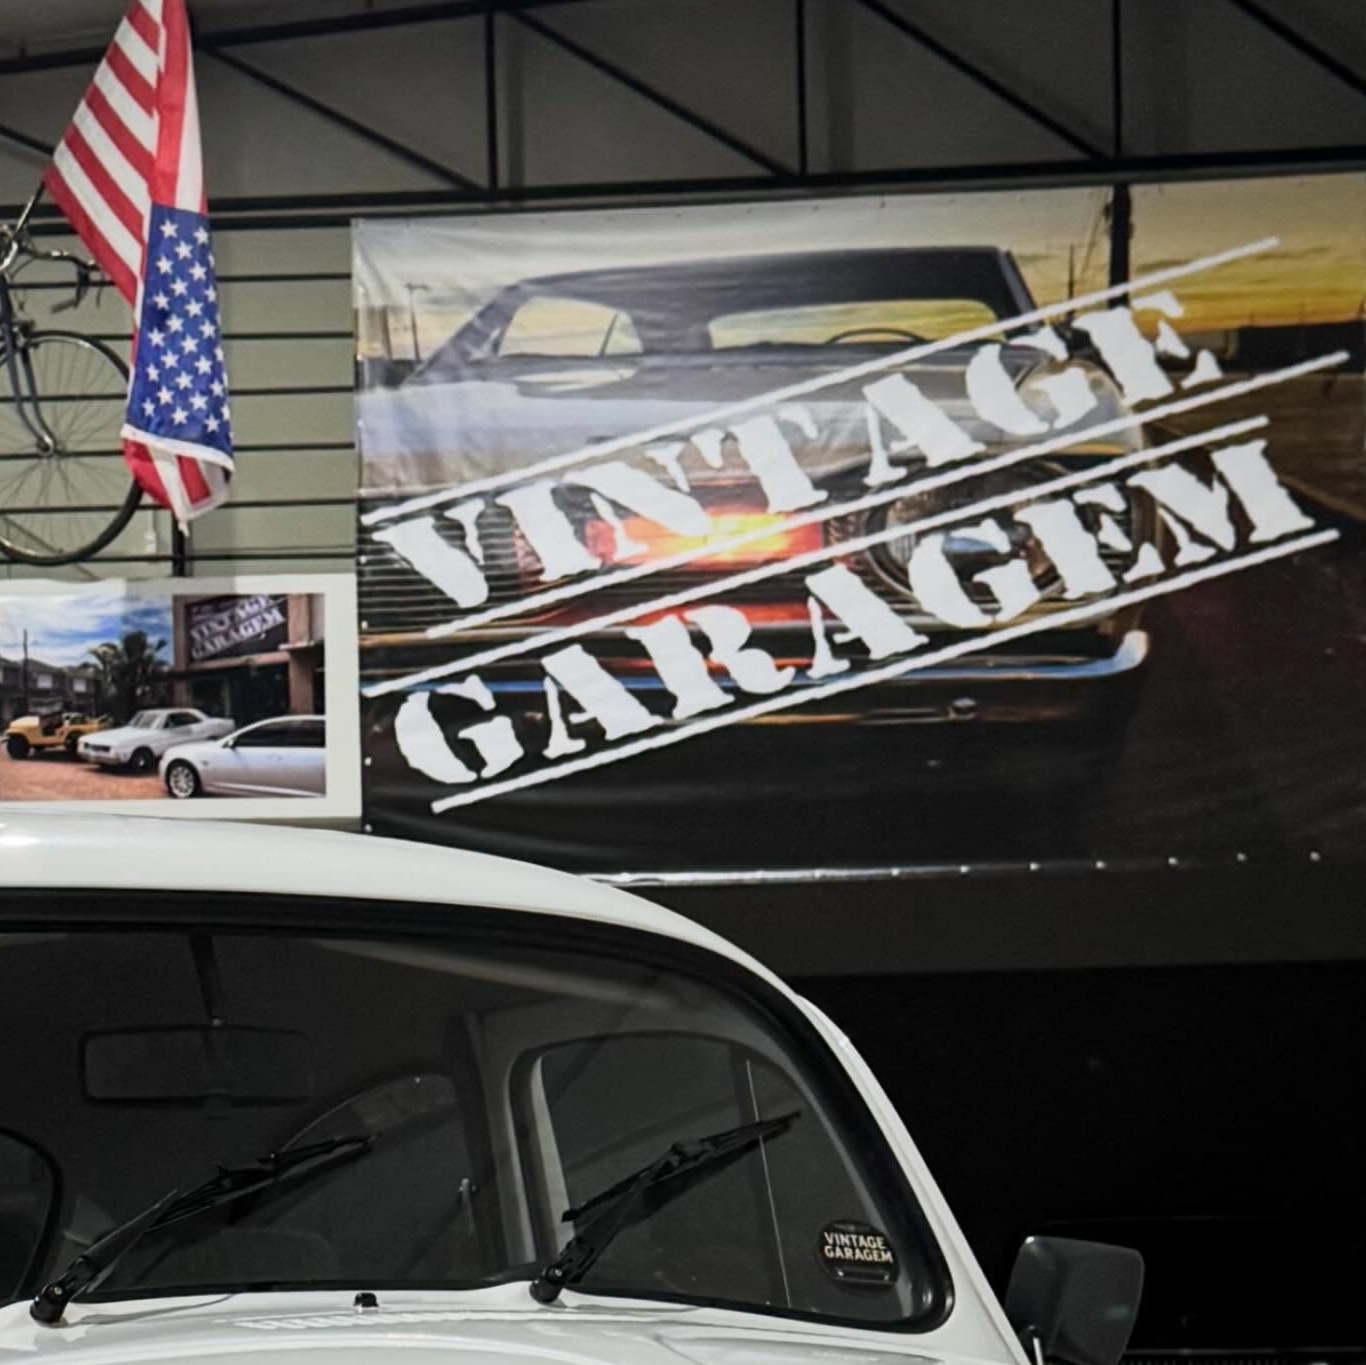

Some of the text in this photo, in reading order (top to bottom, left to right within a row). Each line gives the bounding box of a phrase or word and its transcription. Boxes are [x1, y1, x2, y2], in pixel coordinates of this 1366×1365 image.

[372, 291, 1223, 608] VINTAGE
[395, 440, 1316, 784] GARAGEM
[823, 1231, 886, 1249] VINTAGE
[824, 1245, 893, 1263] GARAGEM
